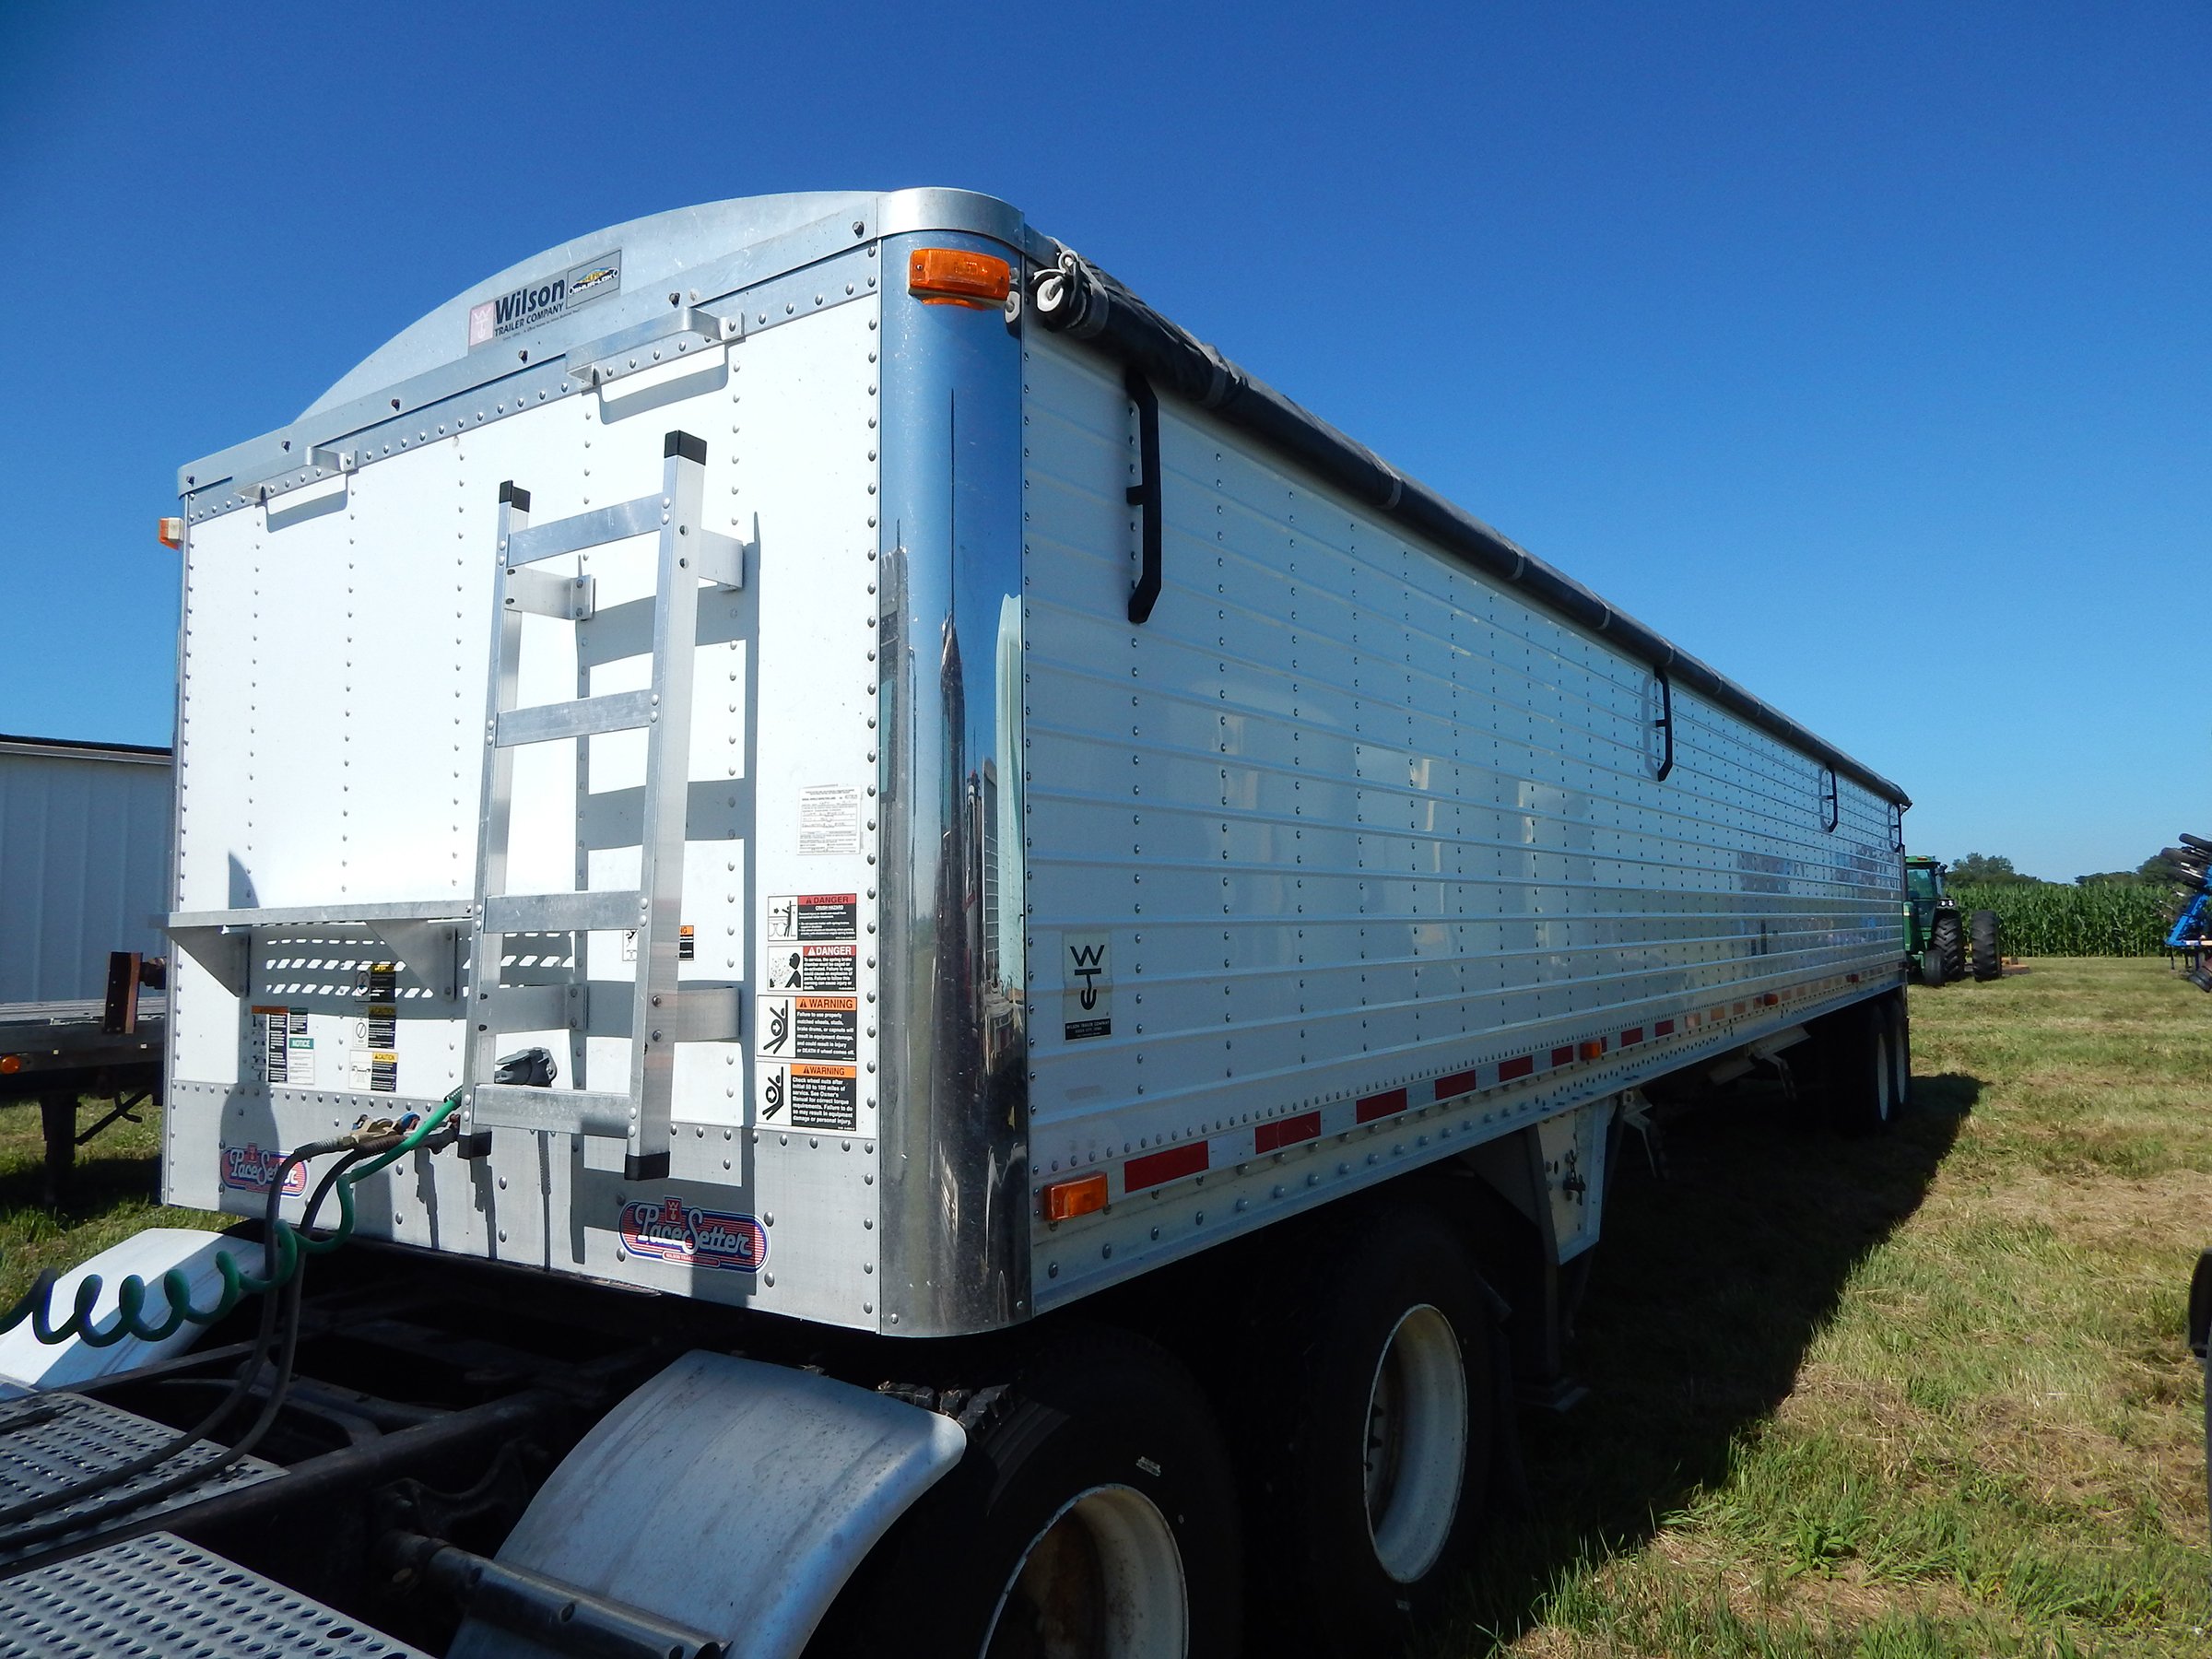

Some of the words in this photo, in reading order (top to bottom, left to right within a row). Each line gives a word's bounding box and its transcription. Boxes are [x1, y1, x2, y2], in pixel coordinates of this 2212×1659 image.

[495, 279, 566, 324] Wilson
[494, 319, 524, 337] TRAILER
[526, 302, 564, 324] COMPANY
[813, 896, 849, 904] DANGER
[816, 947, 852, 956] DANGER
[809, 999, 853, 1008] WARNING
[291, 1040, 311, 1048] NOTICE
[809, 1066, 845, 1076] WARNING
